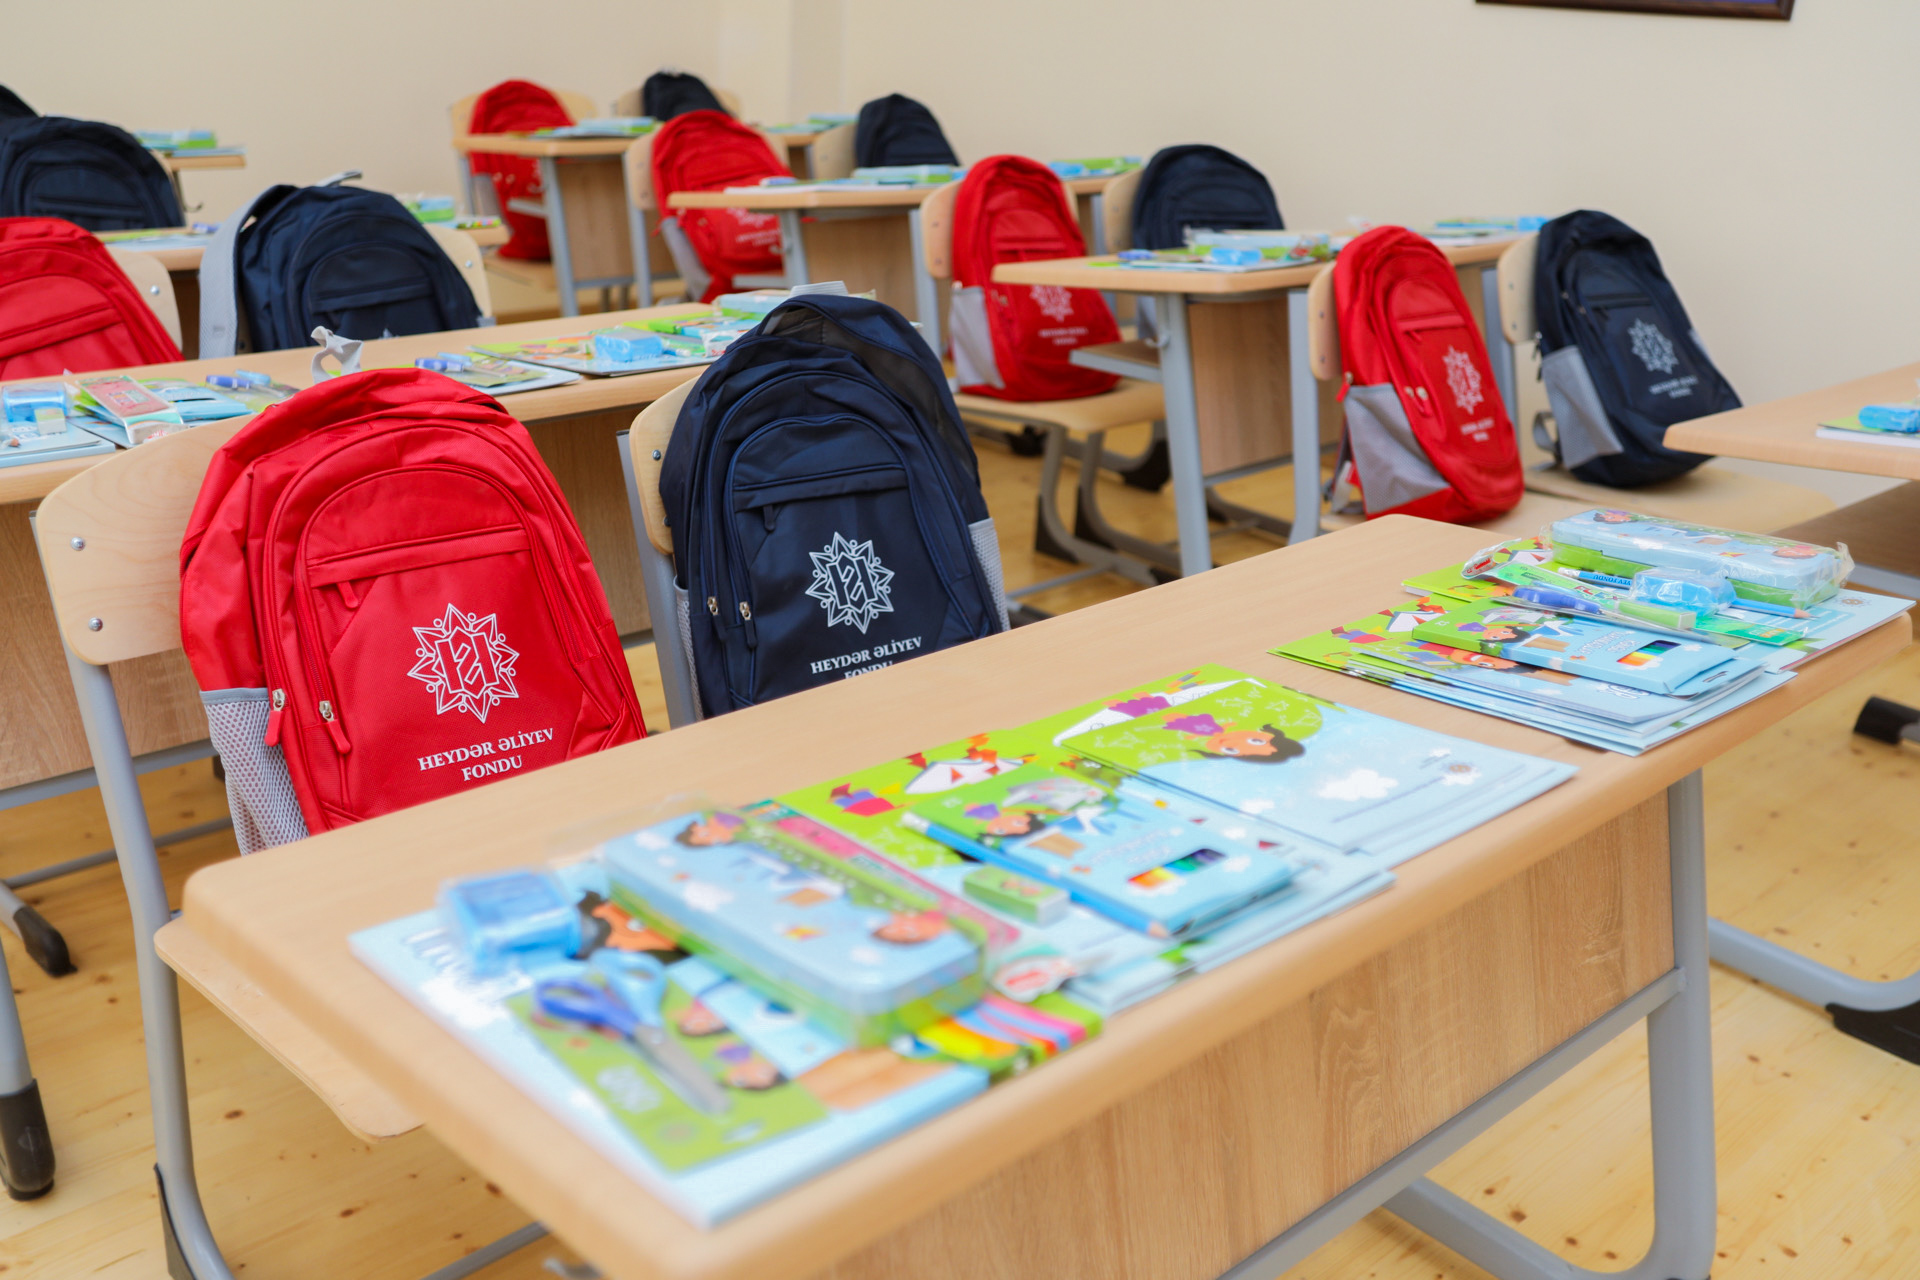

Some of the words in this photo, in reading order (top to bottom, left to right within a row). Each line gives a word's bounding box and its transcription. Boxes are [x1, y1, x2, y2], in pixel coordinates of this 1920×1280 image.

[810, 649, 872, 674] HEYDƏR
[873, 636, 922, 658] ƏLİYEV
[417, 740, 495, 771] HEYDƏR
[497, 727, 554, 752] ƏLİYEV
[461, 755, 523, 782] FONDU
